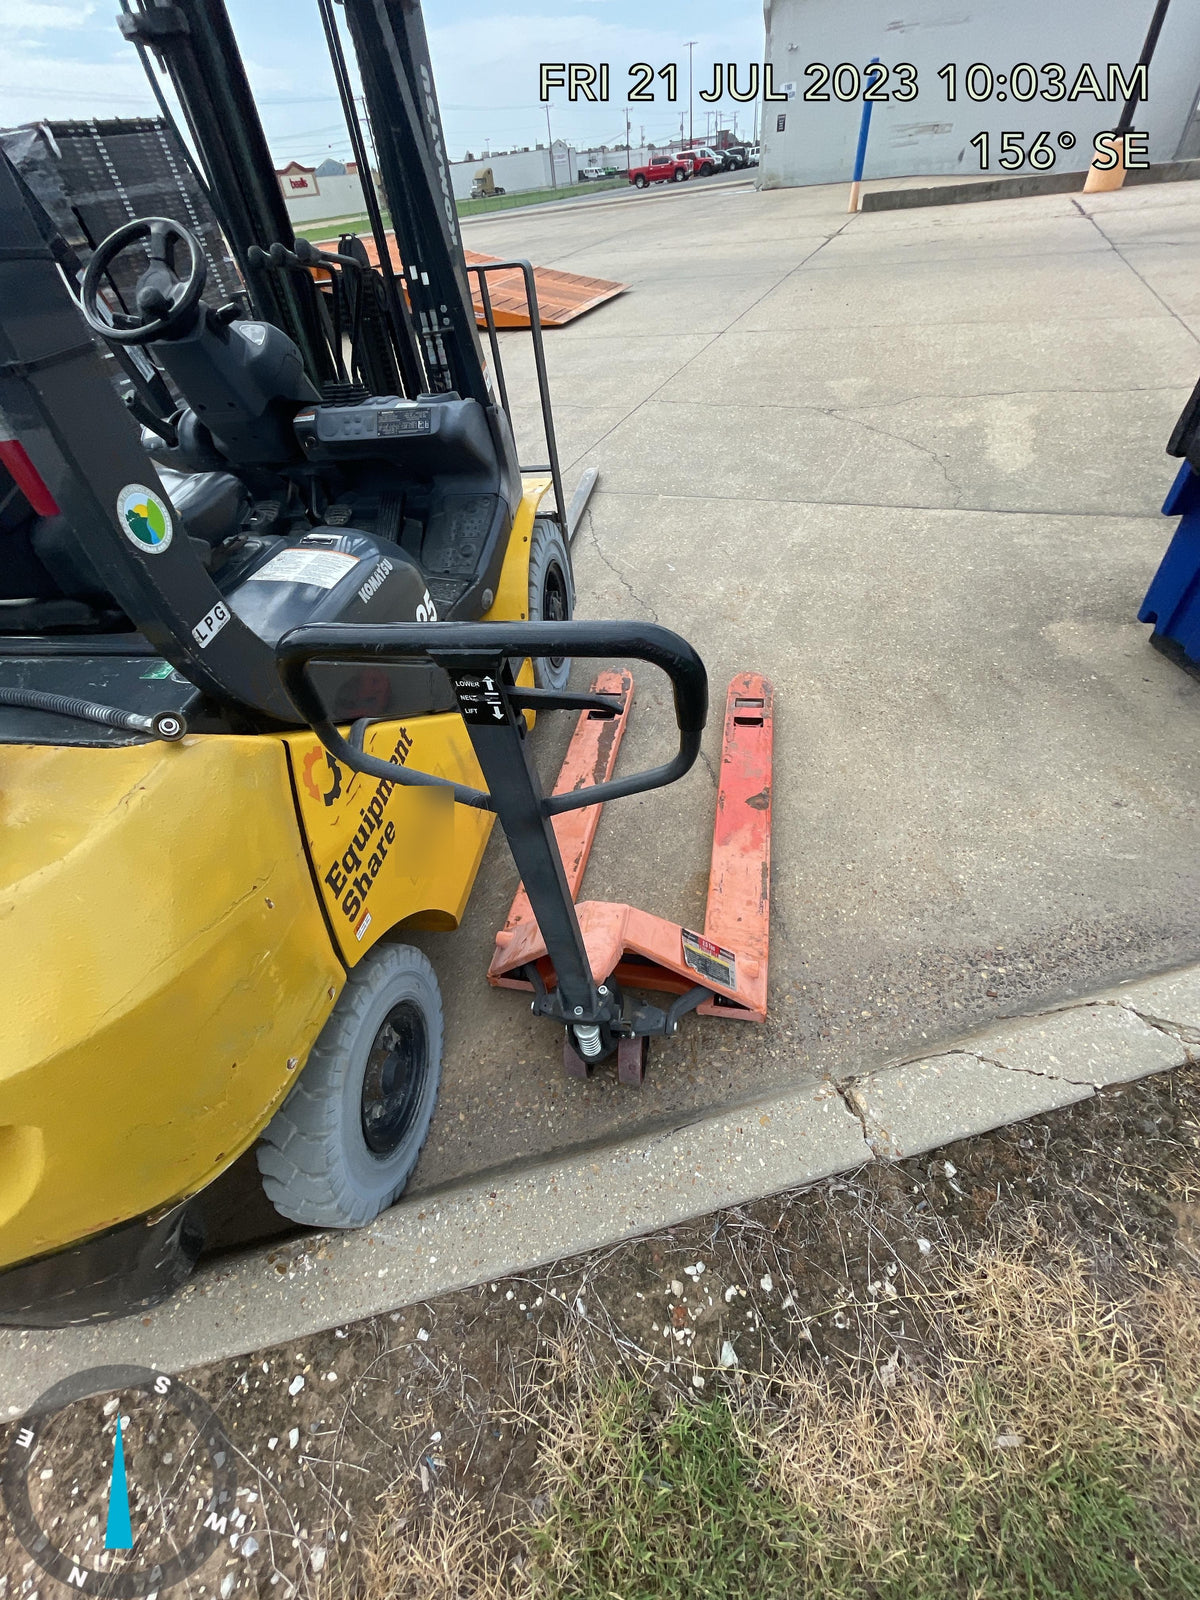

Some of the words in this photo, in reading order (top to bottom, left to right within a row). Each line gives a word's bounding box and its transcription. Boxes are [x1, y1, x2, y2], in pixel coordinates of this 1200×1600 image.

[358, 558, 393, 603] KOMATSU
[455, 680, 480, 688] LOWER
[325, 726, 413, 900] Equipment
[341, 820, 396, 923] Share
